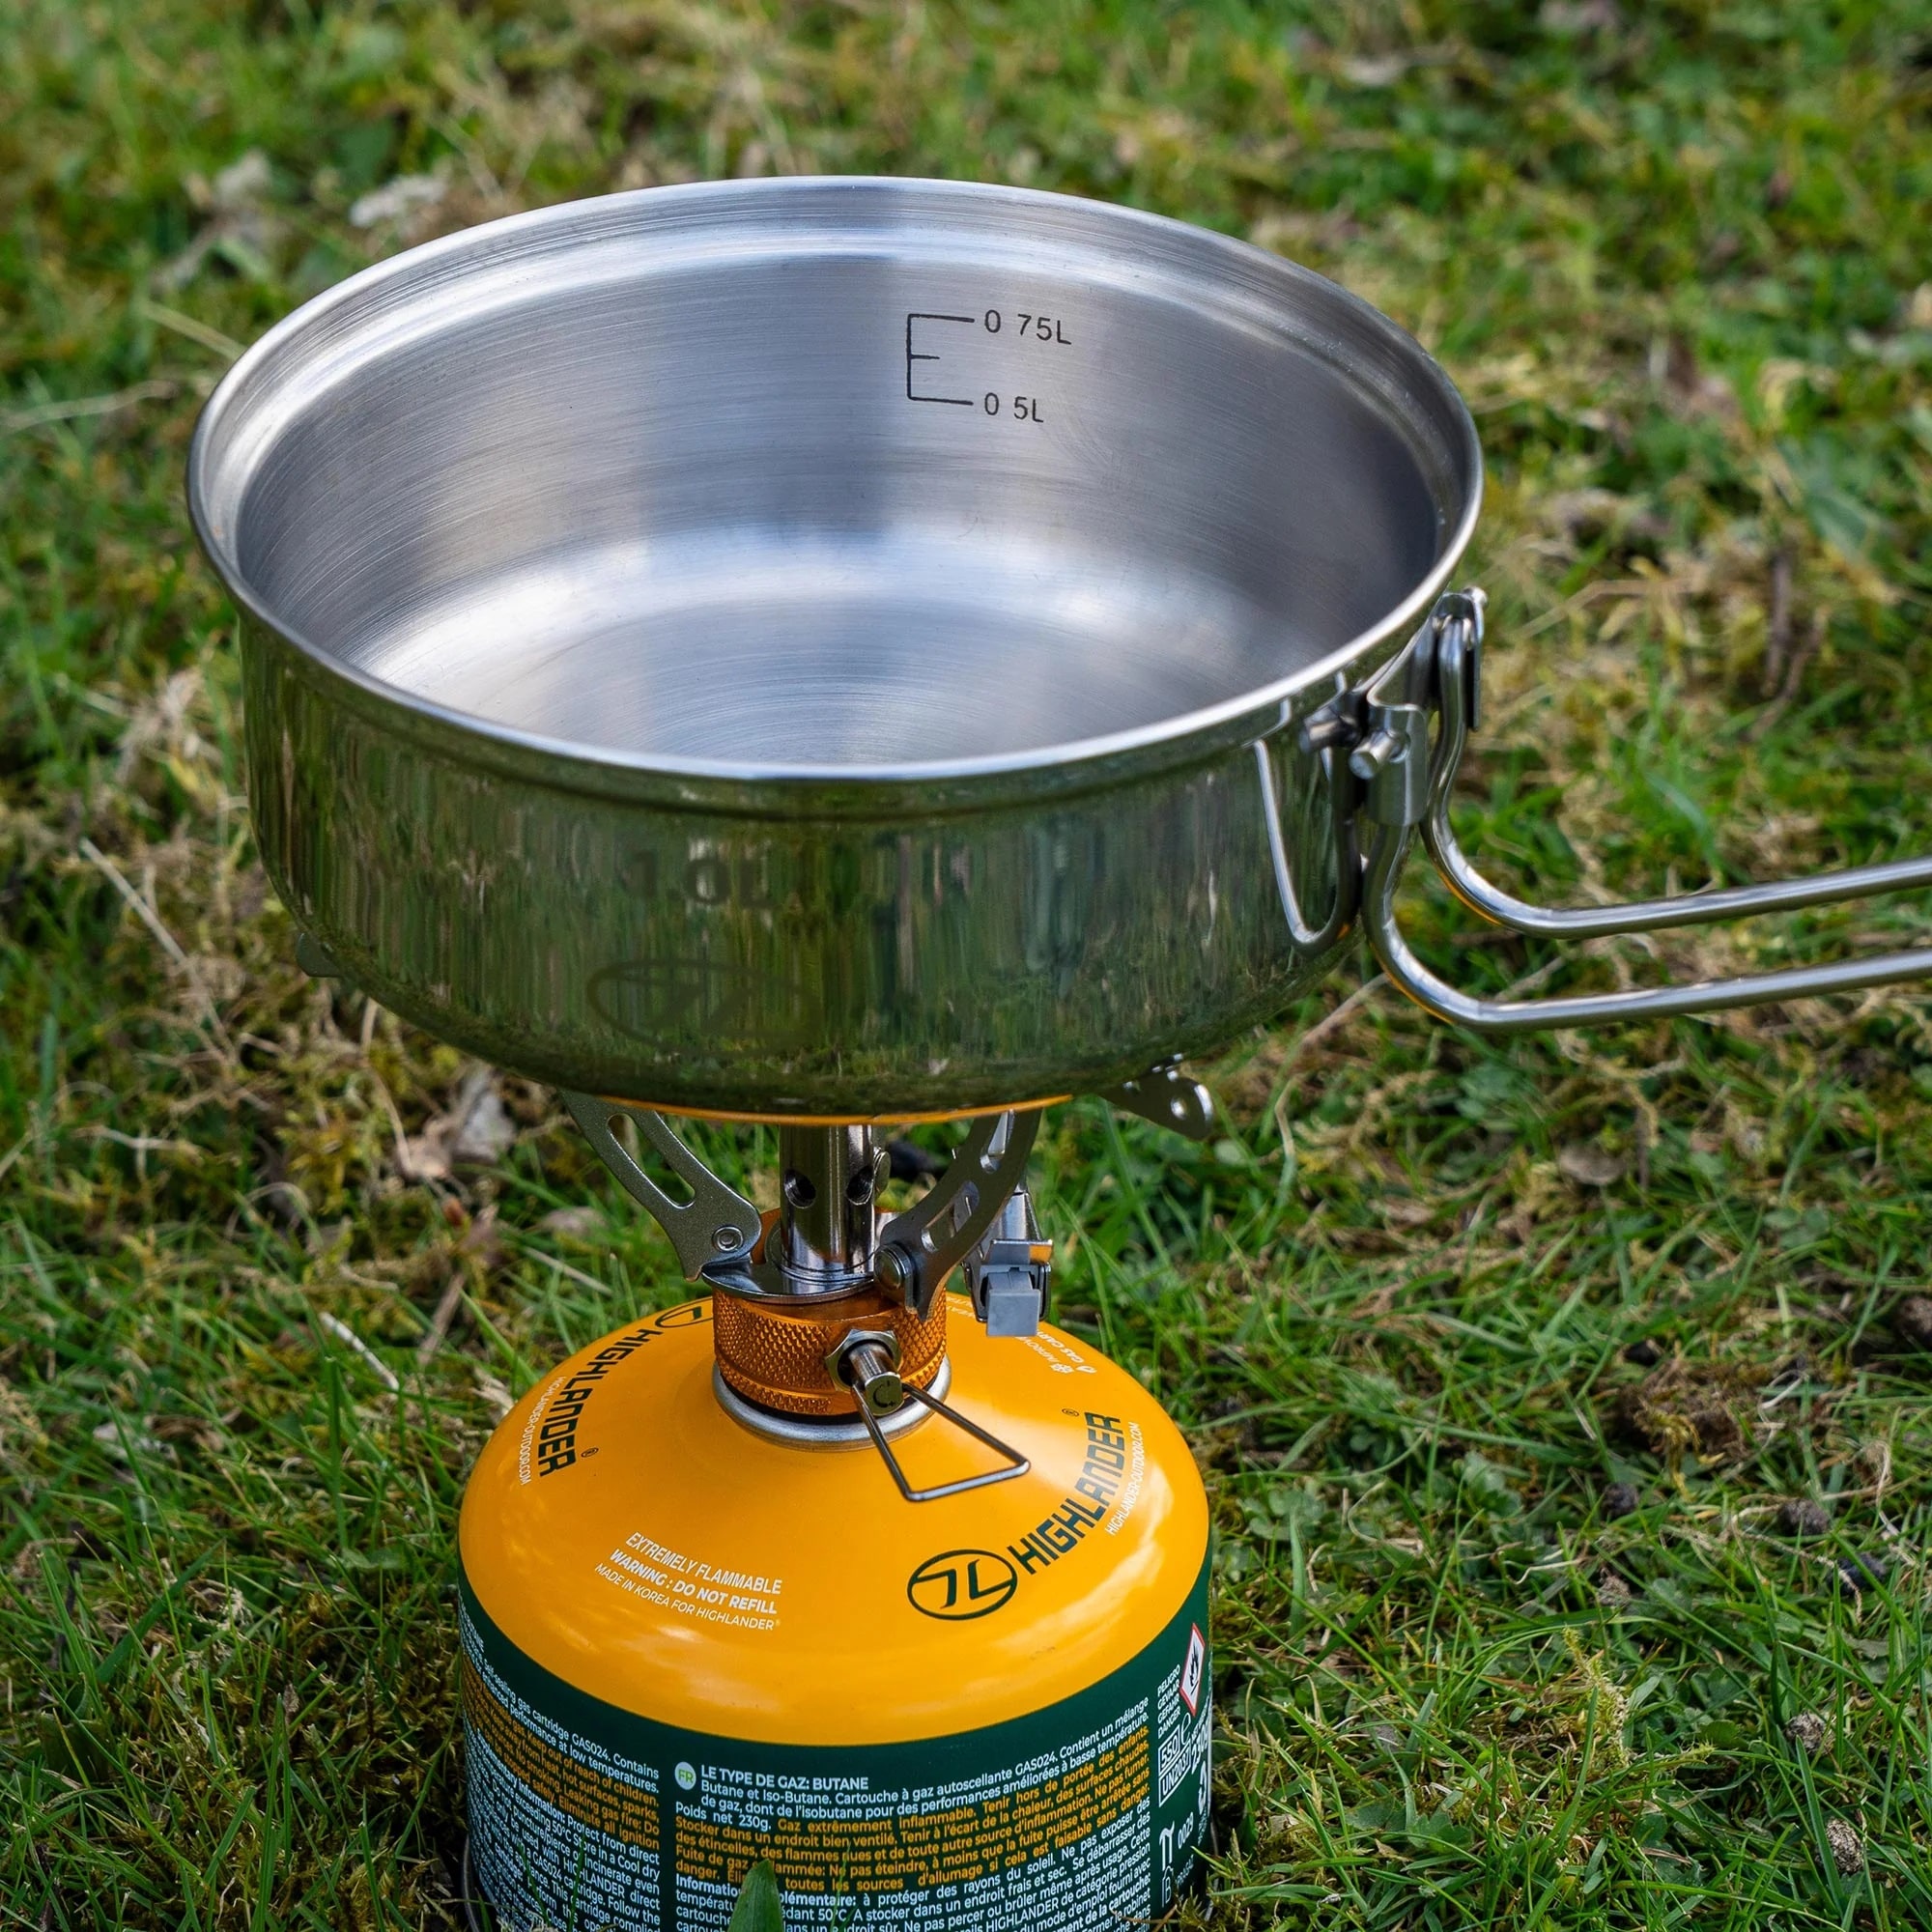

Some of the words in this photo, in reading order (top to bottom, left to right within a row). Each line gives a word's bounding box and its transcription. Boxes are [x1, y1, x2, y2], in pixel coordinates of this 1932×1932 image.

[538, 1328, 664, 1477] HIGHLANDER
[1007, 1411, 1124, 1575] HIGHLANDER
[595, 1562, 622, 1585] MADE
[622, 1578, 634, 1593] IN
[634, 1583, 670, 1607] KOREA
[670, 1599, 695, 1616] FOR
[610, 1548, 666, 1587] WARNING
[672, 1579, 695, 1597] DO
[696, 1585, 727, 1606] NOT
[728, 1595, 778, 1615] REFILL
[626, 1531, 697, 1575] EXTREMELY
[696, 1563, 782, 1595] FLAMMABLE
[1158, 1663, 1180, 1697] PELIGRO
[1158, 1679, 1180, 1711] GEVAAR
[1158, 1693, 1180, 1724] GEFAHR
[1158, 1706, 1181, 1740] DANGER
[510, 1704, 556, 1747] performance
[570, 1747, 585, 1765] low
[587, 1755, 659, 1794] temperatures.
[532, 1709, 569, 1742] cartridge
[572, 1733, 611, 1762] GAS024.
[613, 1752, 659, 1780] Contains
[701, 1779, 744, 1798] Butane
[747, 1787, 759, 1801] et
[763, 1789, 832, 1804] Iso-Butane.
[836, 1789, 898, 1804] Cartouche
[912, 1786, 934, 1804] gaz
[936, 1767, 1012, 1795] autoscellante
[1015, 1750, 1058, 1776] GAS024.
[1060, 1731, 1100, 1759] Contient
[1115, 1696, 1149, 1727] mélange
[701, 1793, 716, 1807] de
[719, 1800, 743, 1814] gaz,
[745, 1801, 774, 1815] dont
[777, 1804, 792, 1817] de
[866, 1804, 894, 1821] pour
[896, 1802, 918, 1816] des
[921, 1785, 1001, 1816] performances
[1003, 1764, 1060, 1794] améliorées
[1069, 1747, 1095, 1771] basse
[1097, 1713, 1150, 1755] température.
[1161, 1735, 1178, 1769] 550
[549, 1747, 562, 1763] out
[575, 1762, 600, 1785] reach
[601, 1775, 612, 1788] of
[613, 1780, 659, 1807] children.
[562, 1770, 578, 1787] hot
[579, 1779, 621, 1809] surfaces,
[622, 1799, 659, 1824] sparks,
[676, 1802, 706, 1820] Poids
[713, 1811, 732, 1825] net
[739, 1814, 772, 1832] 230g.
[778, 1818, 801, 1833] Gaz
[808, 1818, 893, 1833] extrêmement
[898, 1806, 977, 1830] inflammable.
[982, 1796, 1010, 1815] Tenir
[1016, 1787, 1039, 1804] hors
[1063, 1761, 1094, 1788] portée
[1098, 1751, 1115, 1768] des
[1118, 1724, 1150, 1755] enfants.
[700, 1764, 717, 1780] LE
[719, 1768, 753, 1786] TYPE
[755, 1774, 775, 1787] DE
[778, 1776, 810, 1789] GAZ:
[812, 1777, 868, 1791] BUTANE
[1162, 1747, 1190, 1796] UN2037
[558, 1797, 601, 1827] Eliminate
[604, 1819, 615, 1833] all
[619, 1824, 659, 1850] ignition
[563, 1785, 599, 1814] Leaking
[601, 1805, 618, 1824] gas
[643, 1822, 659, 1835] Do
[675, 1815, 719, 1835] Stocker
[722, 1826, 752, 1841] dans
[754, 1832, 771, 1844] un
[774, 1834, 819, 1847] endroit
[823, 1834, 850, 1848] bien
[852, 1833, 897, 1847] ventilé.
[900, 1829, 929, 1844] Tenir
[944, 1820, 980, 1837] l'écart
[1012, 1797, 1054, 1820] chaleur,
[1075, 1767, 1114, 1796] surfaces
[567, 1812, 600, 1841] Protect
[601, 1832, 626, 1854] from
[629, 1839, 660, 1865] direct
[598, 1843, 608, 1861] in
[617, 1852, 639, 1873] Cool
[641, 1863, 661, 1881] dry
[676, 1831, 696, 1845] des
[698, 1834, 758, 1858] étincelles,
[760, 1845, 782, 1860] des
[785, 1847, 839, 1861] flammes
[890, 1846, 904, 1860] de
[907, 1843, 939, 1859] toute
[942, 1834, 972, 1853] autre
[975, 1828, 1012, 1845] source
[676, 1844, 704, 1861] Fuite
[708, 1852, 723, 1864] de
[727, 1857, 749, 1871] gaz
[850, 1866, 871, 1879] pas
[875, 1860, 928, 1876] éteindre,
[943, 1849, 979, 1867] moins
[1046, 1816, 1077, 1842] puisse
[676, 1859, 720, 1880] danger.
[785, 1877, 825, 1890] toutes
[856, 1880, 903, 1891] sources
[917, 1863, 983, 1888] d'allumage
[1005, 1850, 1027, 1868] cela
[1055, 1824, 1093, 1849] faisable
[584, 1854, 633, 1886] incinerate
[635, 1877, 660, 1895] even
[866, 1907, 910, 1921] stocker
[913, 1901, 942, 1918] dans
[964, 1888, 1006, 1909] endroit
[1008, 1878, 1032, 1896] frais
[1087, 1824, 1136, 1862] débarrasser
[878, 1889, 929, 1908] protéger
[936, 1885, 957, 1899] des
[964, 1874, 1001, 1895] rayons
[1027, 1855, 1056, 1876] soleil.
[608, 1895, 639, 1919] Follow
[642, 1909, 661, 1926] the
[630, 1889, 660, 1911] direct
[948, 1910, 983, 1931] percer
[1005, 1892, 1037, 1914] brûler
[1039, 1877, 1072, 1900] même
[986, 1897, 1059, 1932] HIGHLANDER
